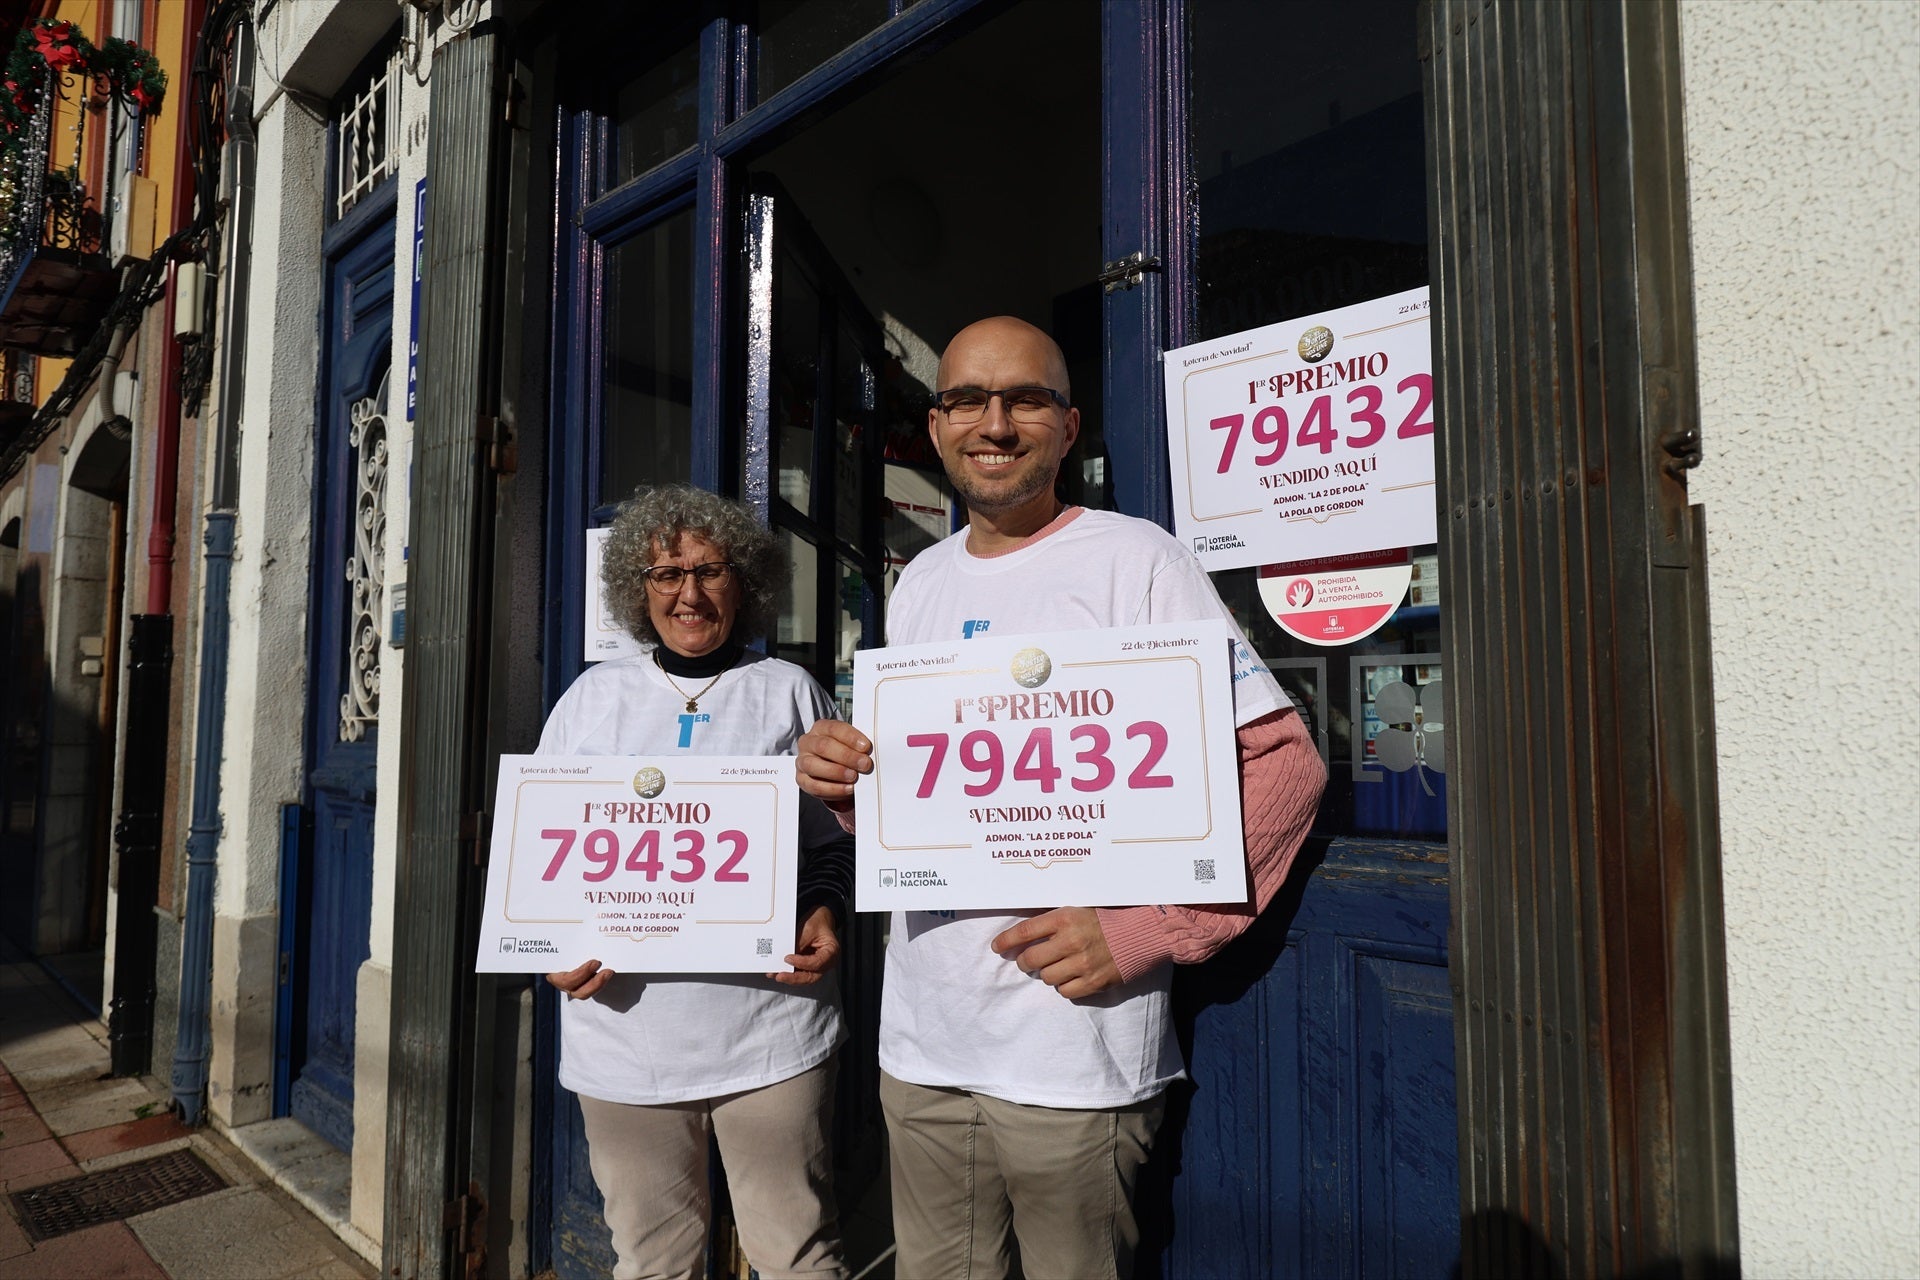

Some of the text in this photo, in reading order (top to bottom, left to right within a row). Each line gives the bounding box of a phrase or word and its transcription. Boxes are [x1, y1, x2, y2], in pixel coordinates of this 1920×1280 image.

[1399, 305, 1409, 314] 22
[1410, 303, 1421, 311] de
[1269, 351, 1389, 398] PREMIO
[1209, 373, 1434, 474] 79432
[1259, 453, 1377, 489] VENDIDO AQUÍ
[1273, 494, 1306, 505] ADMON.
[1330, 487, 1341, 496] DE
[1279, 499, 1364, 519] LA POLA DE GORDON
[1209, 534, 1237, 544] LOTERÍA
[1209, 541, 1246, 551] NACIONAL
[1273, 562, 1297, 571] JUEGA
[1318, 549, 1394, 564] RESPONSABILIDAD
[1317, 576, 1357, 585] PROHIBIDA
[1318, 591, 1384, 603] AUTOPROHIBIDOS
[1328, 586, 1353, 594] VENTA
[1121, 638, 1199, 650] 22 de Diciembre
[908, 659, 919, 667] de
[978, 688, 1114, 722] PREMIO
[678, 713, 710, 747] 1ER
[906, 720, 1174, 799] 79432
[604, 802, 711, 824] PREMIO
[969, 799, 1106, 823] VENDIDO AQUÍ
[985, 833, 1025, 842] ADMON.
[1045, 832, 1051, 840] 2
[1052, 832, 1065, 840] DE
[540, 829, 750, 883] 79432
[992, 848, 1091, 859] LA POLA DE GORDON
[900, 869, 938, 879] LOTERÍA
[900, 879, 948, 887] NACIONAL
[584, 889, 695, 907] VENDIDO AQUÍ
